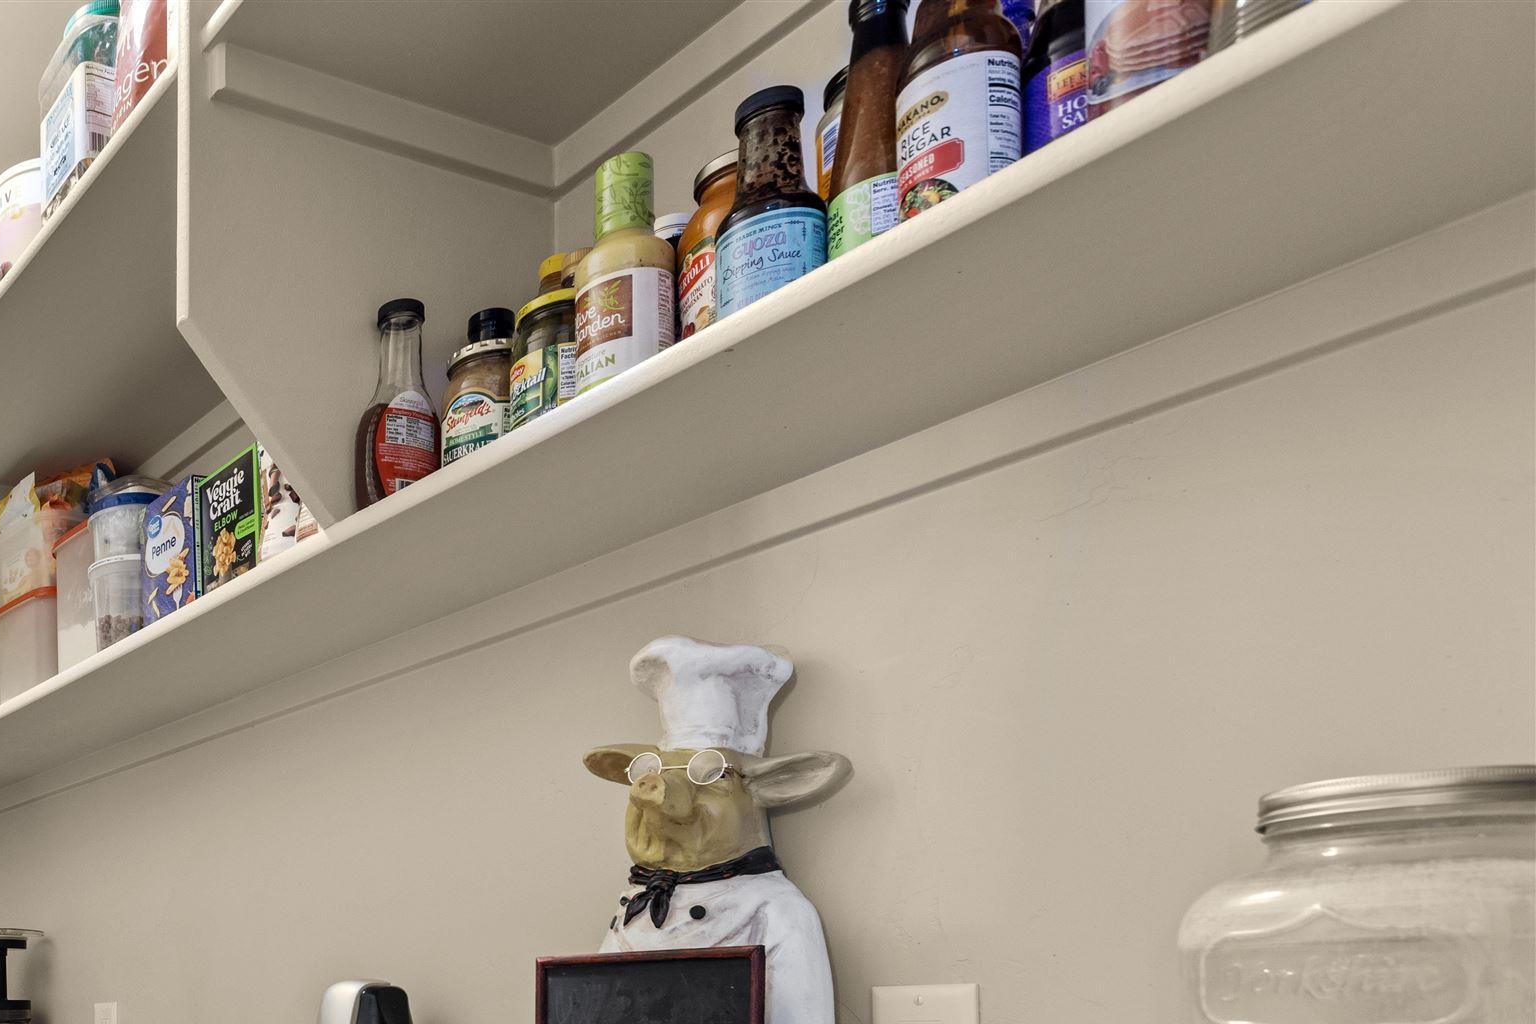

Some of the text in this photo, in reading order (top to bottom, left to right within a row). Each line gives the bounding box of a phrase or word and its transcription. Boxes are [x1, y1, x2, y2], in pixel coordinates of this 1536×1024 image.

[1058, 95, 1088, 118] HO
[1062, 109, 1088, 130] SA
[900, 126, 952, 163] NEGAR
[723, 256, 764, 282] Dipping
[768, 248, 802, 263] Sauce
[576, 305, 597, 328] live
[576, 312, 625, 351] arden
[576, 353, 616, 381] TALIAN
[443, 440, 488, 465] SAUERKRA
[205, 467, 245, 505] Veggie
[209, 490, 241, 521] Craft
[214, 509, 239, 532] ELBOW
[151, 535, 177, 560] Penne
